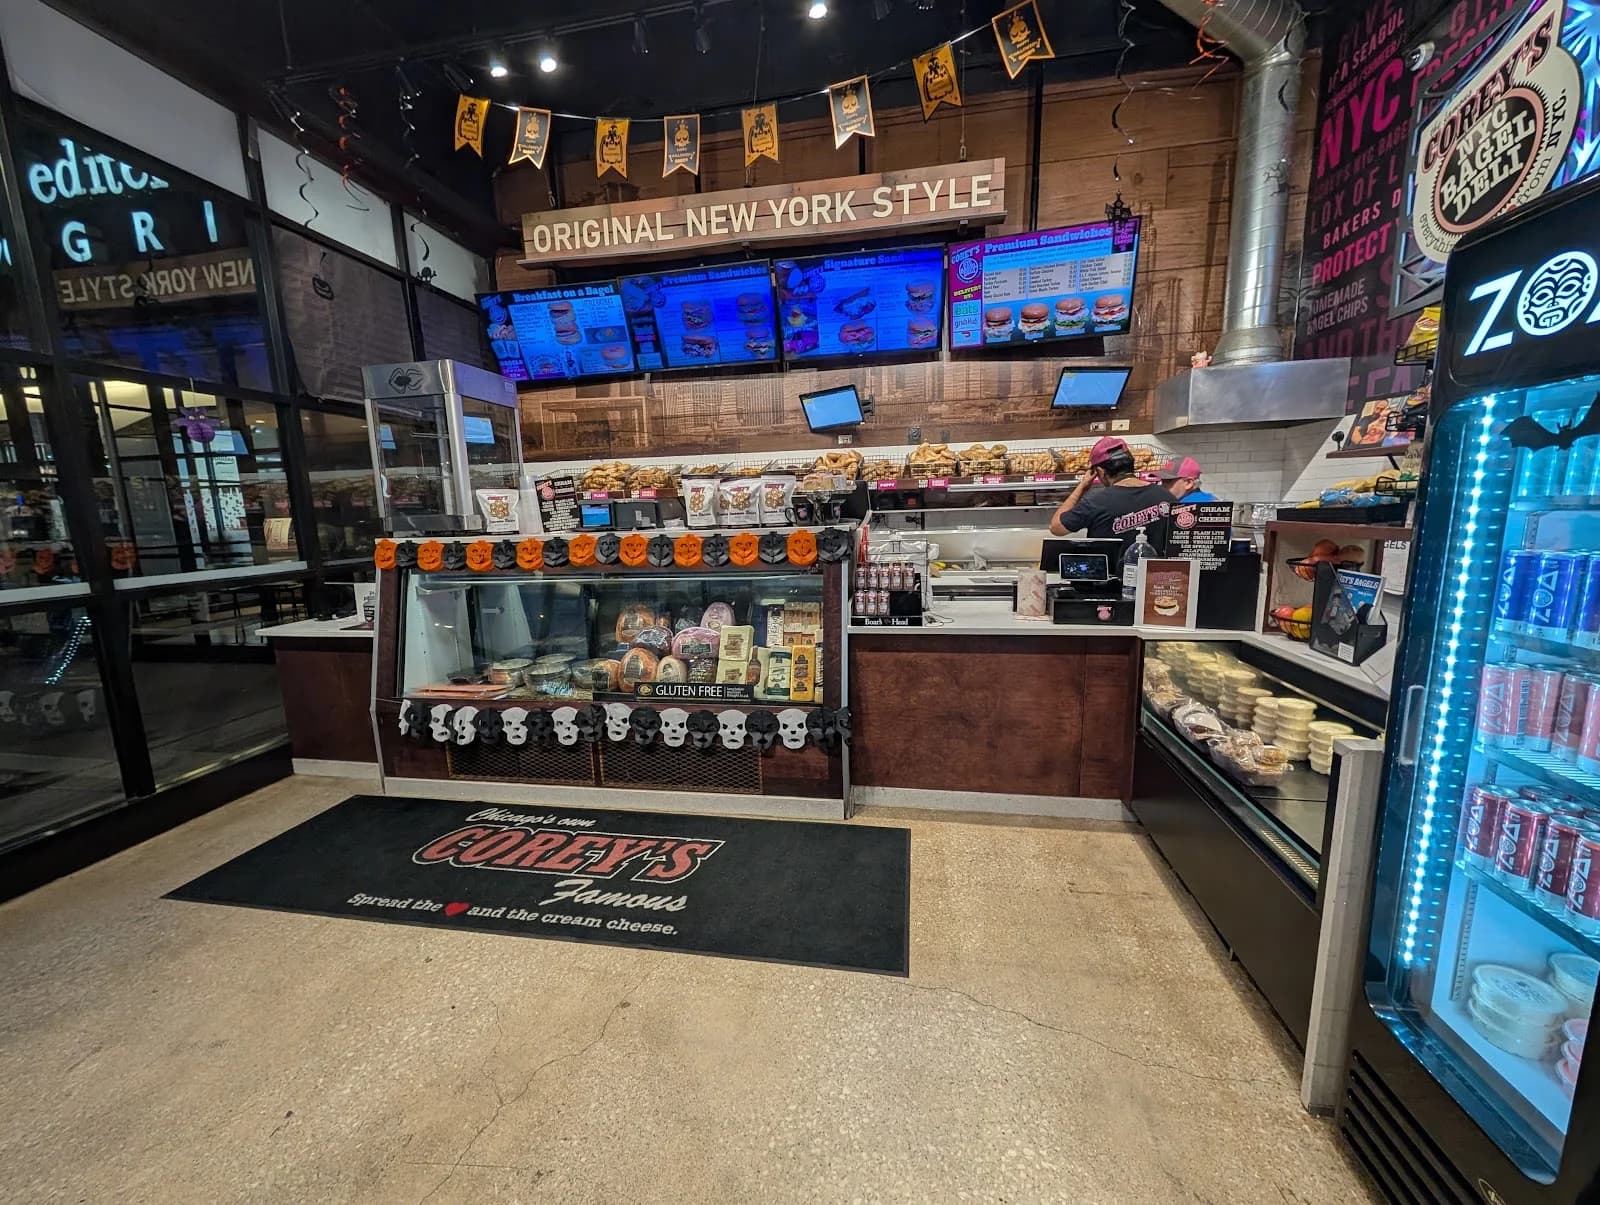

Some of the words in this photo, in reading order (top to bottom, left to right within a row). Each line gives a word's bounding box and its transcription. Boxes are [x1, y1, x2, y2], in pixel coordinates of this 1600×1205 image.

[1419, 10, 1556, 174] COREY'S
[1315, 58, 1404, 178] NYC
[1456, 101, 1508, 166] NYC
[1441, 110, 1536, 210] BAGEL
[1454, 143, 1524, 222] DELI
[533, 213, 674, 253] ORIGINAL
[686, 201, 758, 238] NEW
[768, 190, 857, 229] YORK
[872, 174, 993, 218] STYLE
[1323, 200, 1382, 250] BAKERS
[985, 238, 1038, 253] Premium
[1040, 226, 1113, 245] Sandwiches
[1311, 222, 1393, 290] PROTECT
[824, 256, 876, 271] Signature
[513, 288, 563, 303] Breakfast
[585, 284, 615, 298] Bagel
[1306, 308, 1337, 337] BAGEL
[1336, 296, 1369, 323] CHIPS
[1112, 504, 1160, 533] COREY'S
[1353, 577, 1380, 590] BAGELS
[891, 617, 909, 626] Head
[655, 684, 696, 696] GLUTEN
[698, 685, 723, 697] FREE
[465, 807, 557, 827] Chicago's
[557, 818, 596, 828] own
[413, 825, 720, 882] COREY'S
[346, 892, 408, 911] Spread
[411, 896, 444, 913] the
[467, 905, 502, 919] and
[506, 907, 539, 923] the
[541, 911, 602, 929] cream
[606, 918, 678, 936] cheese.
[538, 879, 689, 913] Famous
